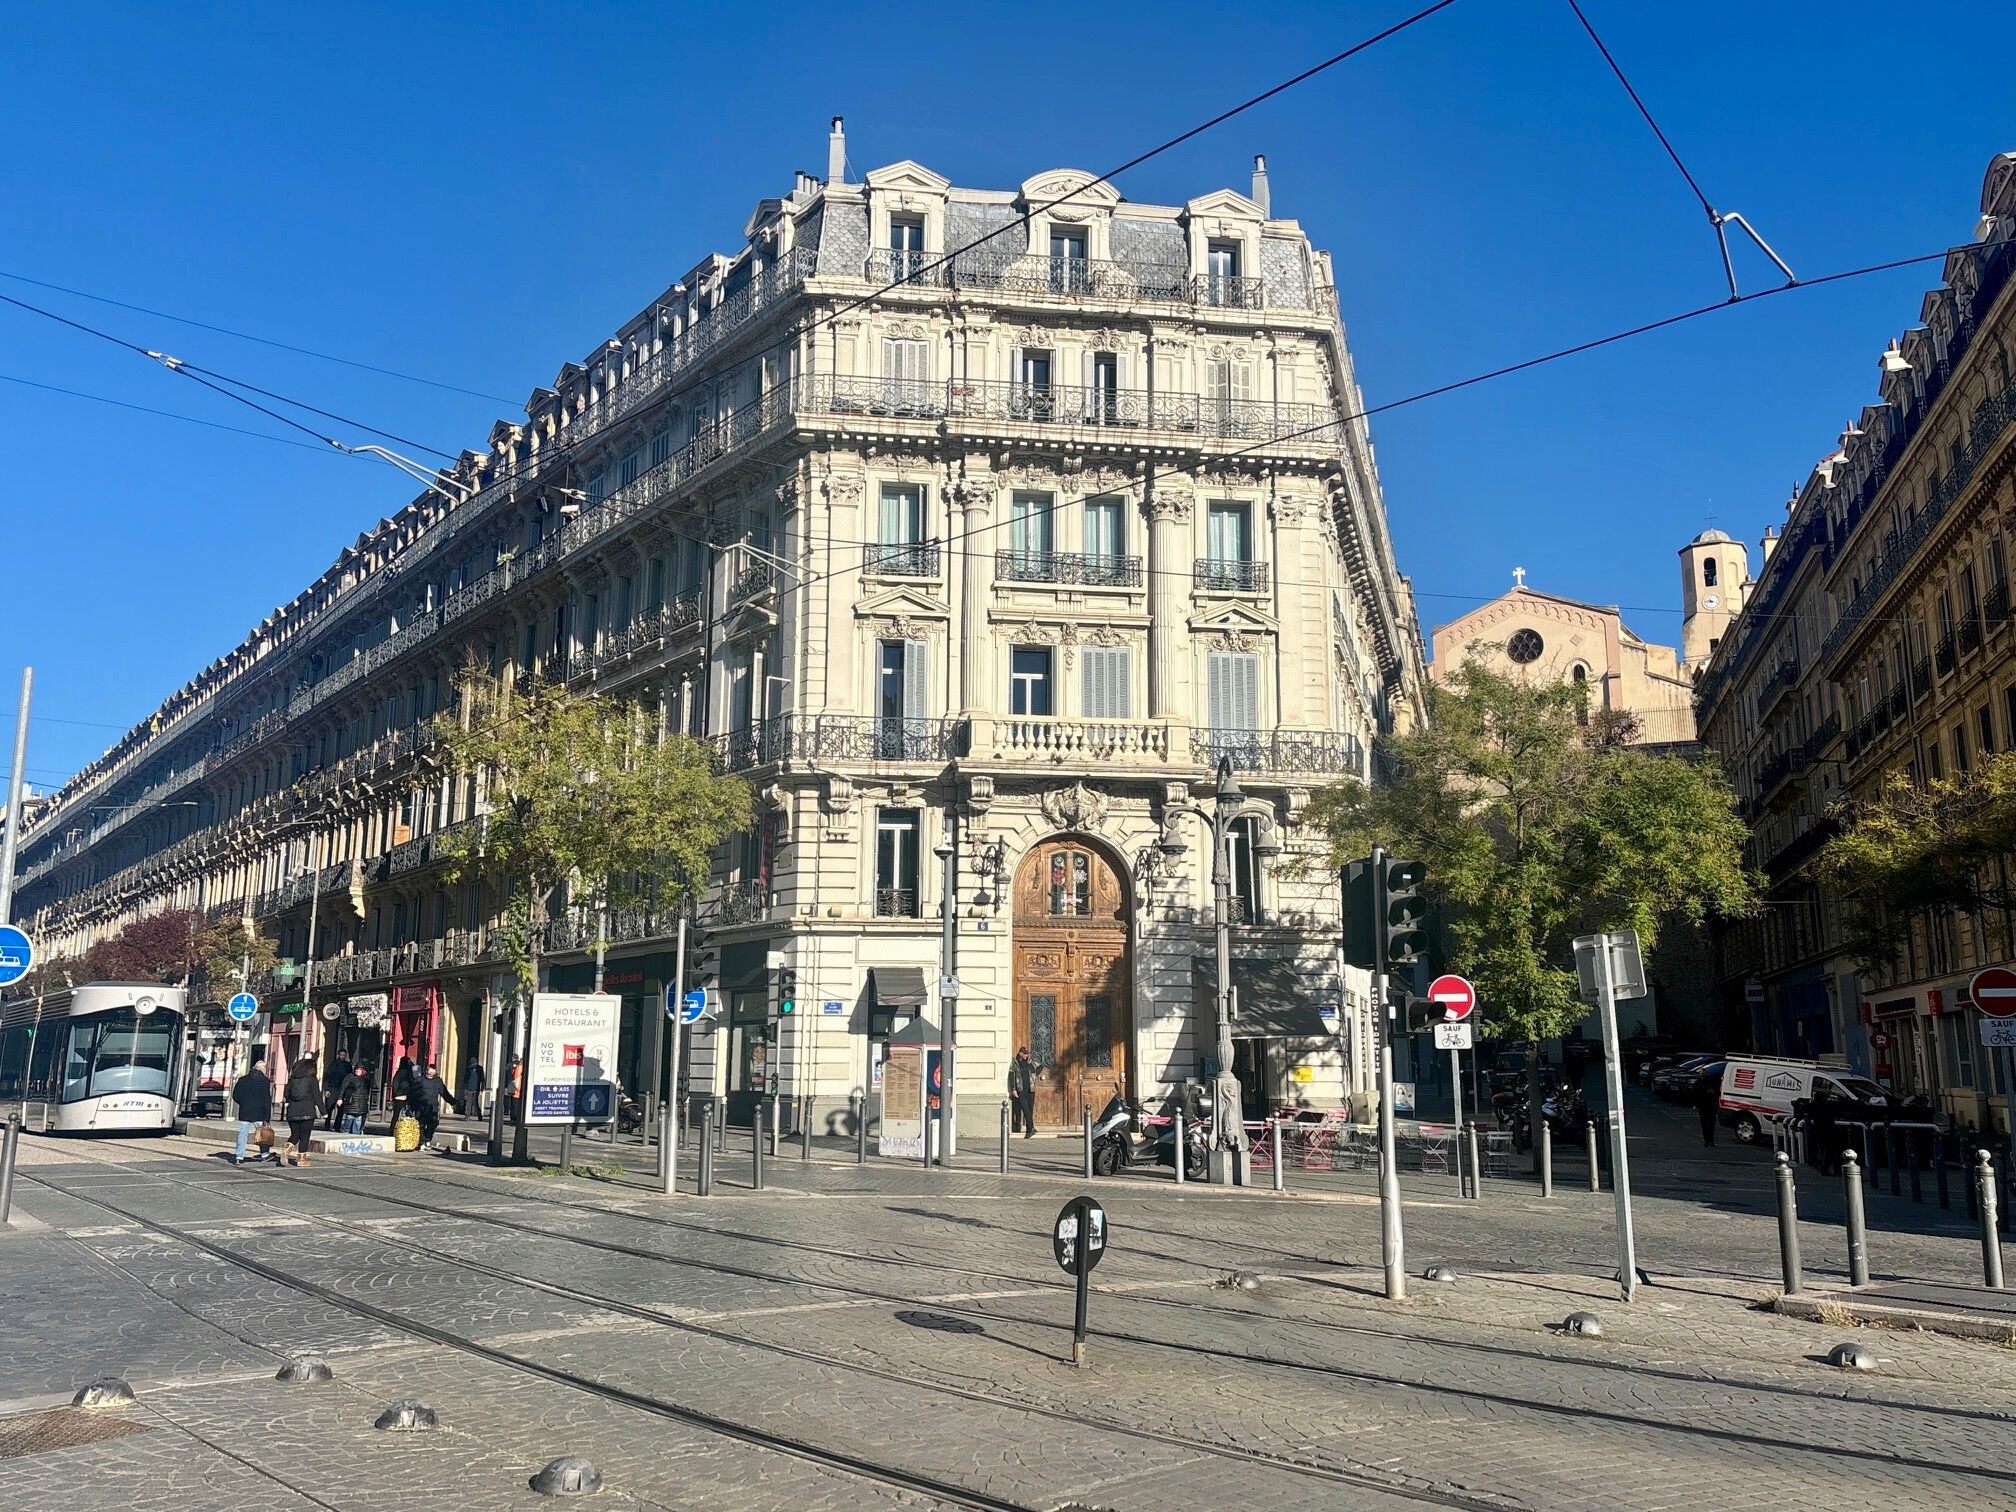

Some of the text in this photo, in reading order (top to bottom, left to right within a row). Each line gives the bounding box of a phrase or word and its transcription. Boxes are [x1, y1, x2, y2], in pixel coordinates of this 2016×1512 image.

[555, 1008, 590, 1016] HOTELS
[545, 1018, 607, 1027] RESTAURANT
[1991, 1020, 2015, 1028] SAUF
[566, 1050, 581, 1059] ibis
